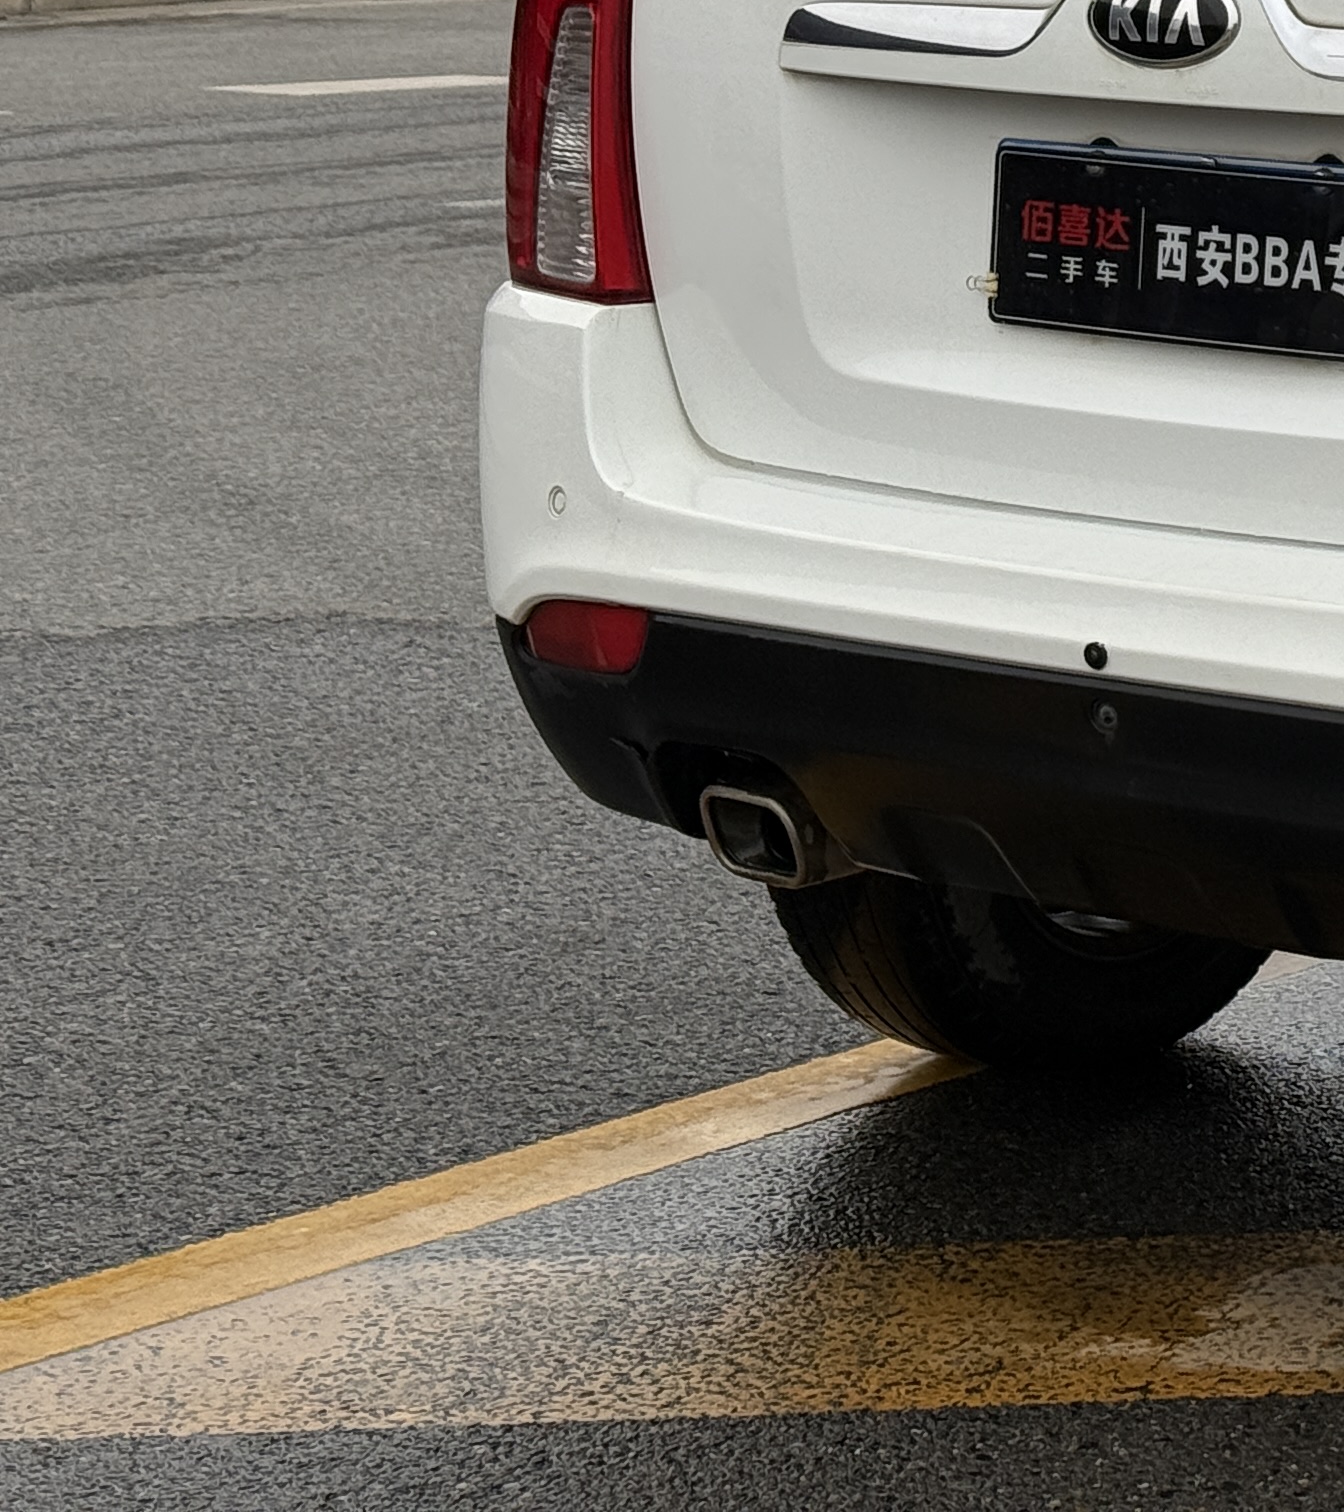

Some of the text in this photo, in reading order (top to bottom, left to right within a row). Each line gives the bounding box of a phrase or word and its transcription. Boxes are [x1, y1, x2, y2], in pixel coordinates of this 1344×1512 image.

[1021, 199, 1131, 252] 佰喜达
[1025, 252, 1119, 288] 二手车
